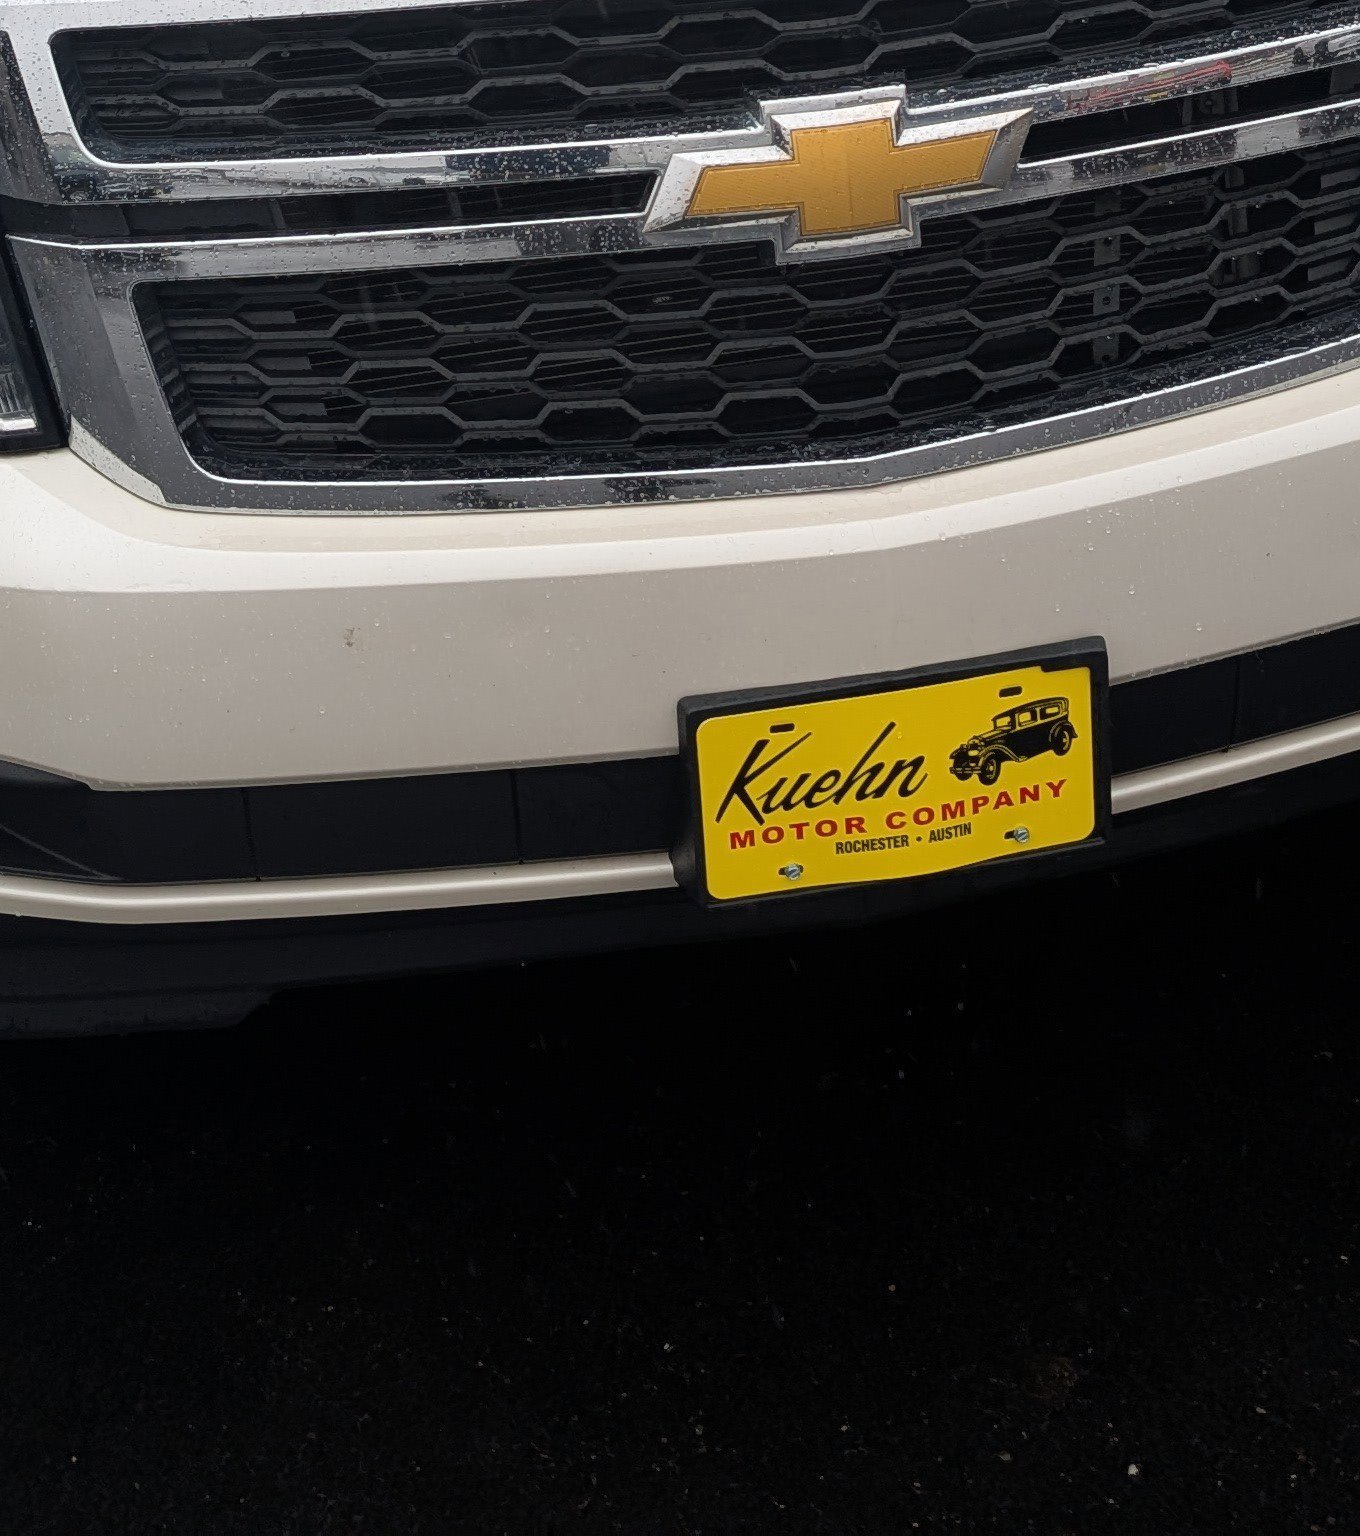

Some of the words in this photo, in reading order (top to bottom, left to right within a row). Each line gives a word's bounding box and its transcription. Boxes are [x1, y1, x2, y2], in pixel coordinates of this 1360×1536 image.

[714, 721, 929, 826] Kuehn
[729, 816, 867, 850] MOTOR
[885, 778, 1068, 830] COMPANY
[835, 834, 910, 855] ROCHESTER
[928, 822, 972, 843] AUSTIN
